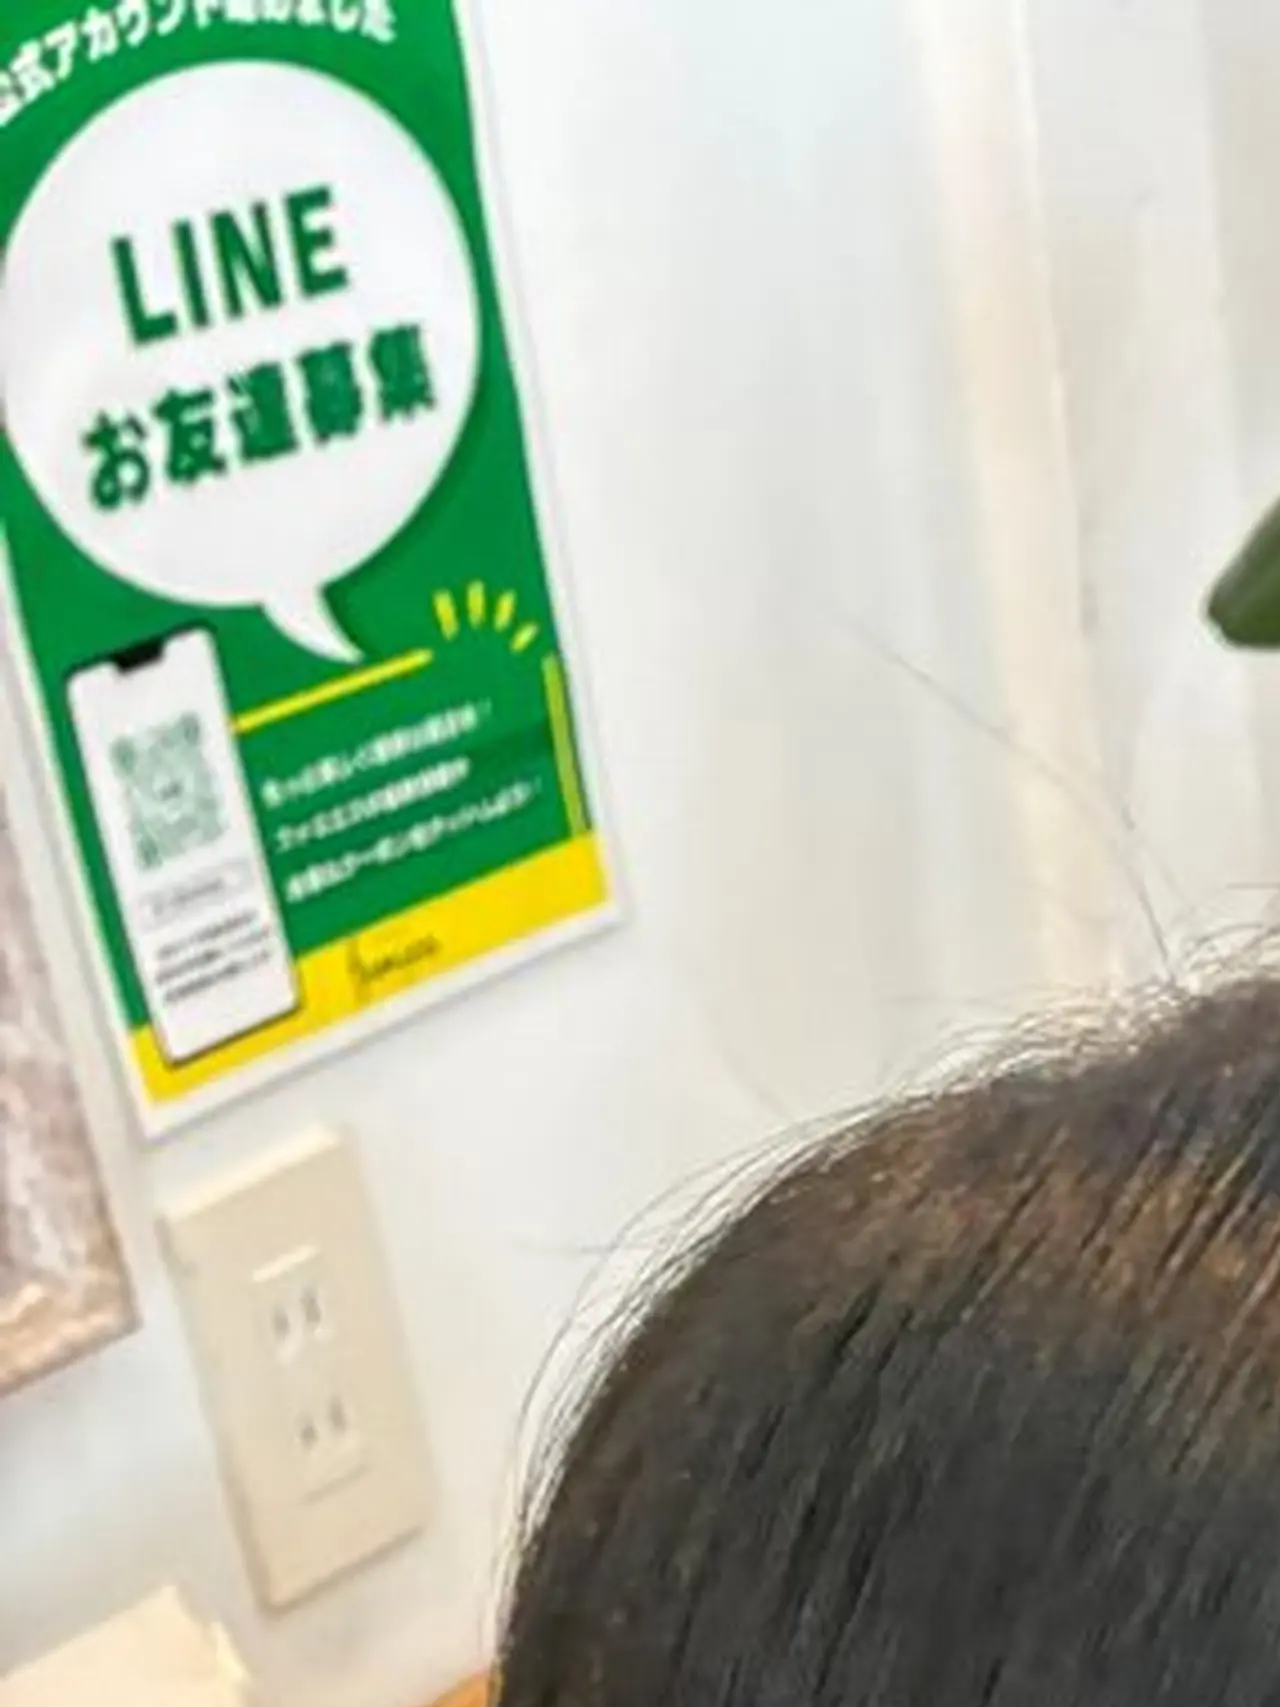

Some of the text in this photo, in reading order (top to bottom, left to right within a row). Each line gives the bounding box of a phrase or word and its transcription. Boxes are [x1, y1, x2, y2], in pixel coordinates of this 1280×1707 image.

[111, 186, 349, 346] LINE
[82, 324, 436, 510] お友達募集
